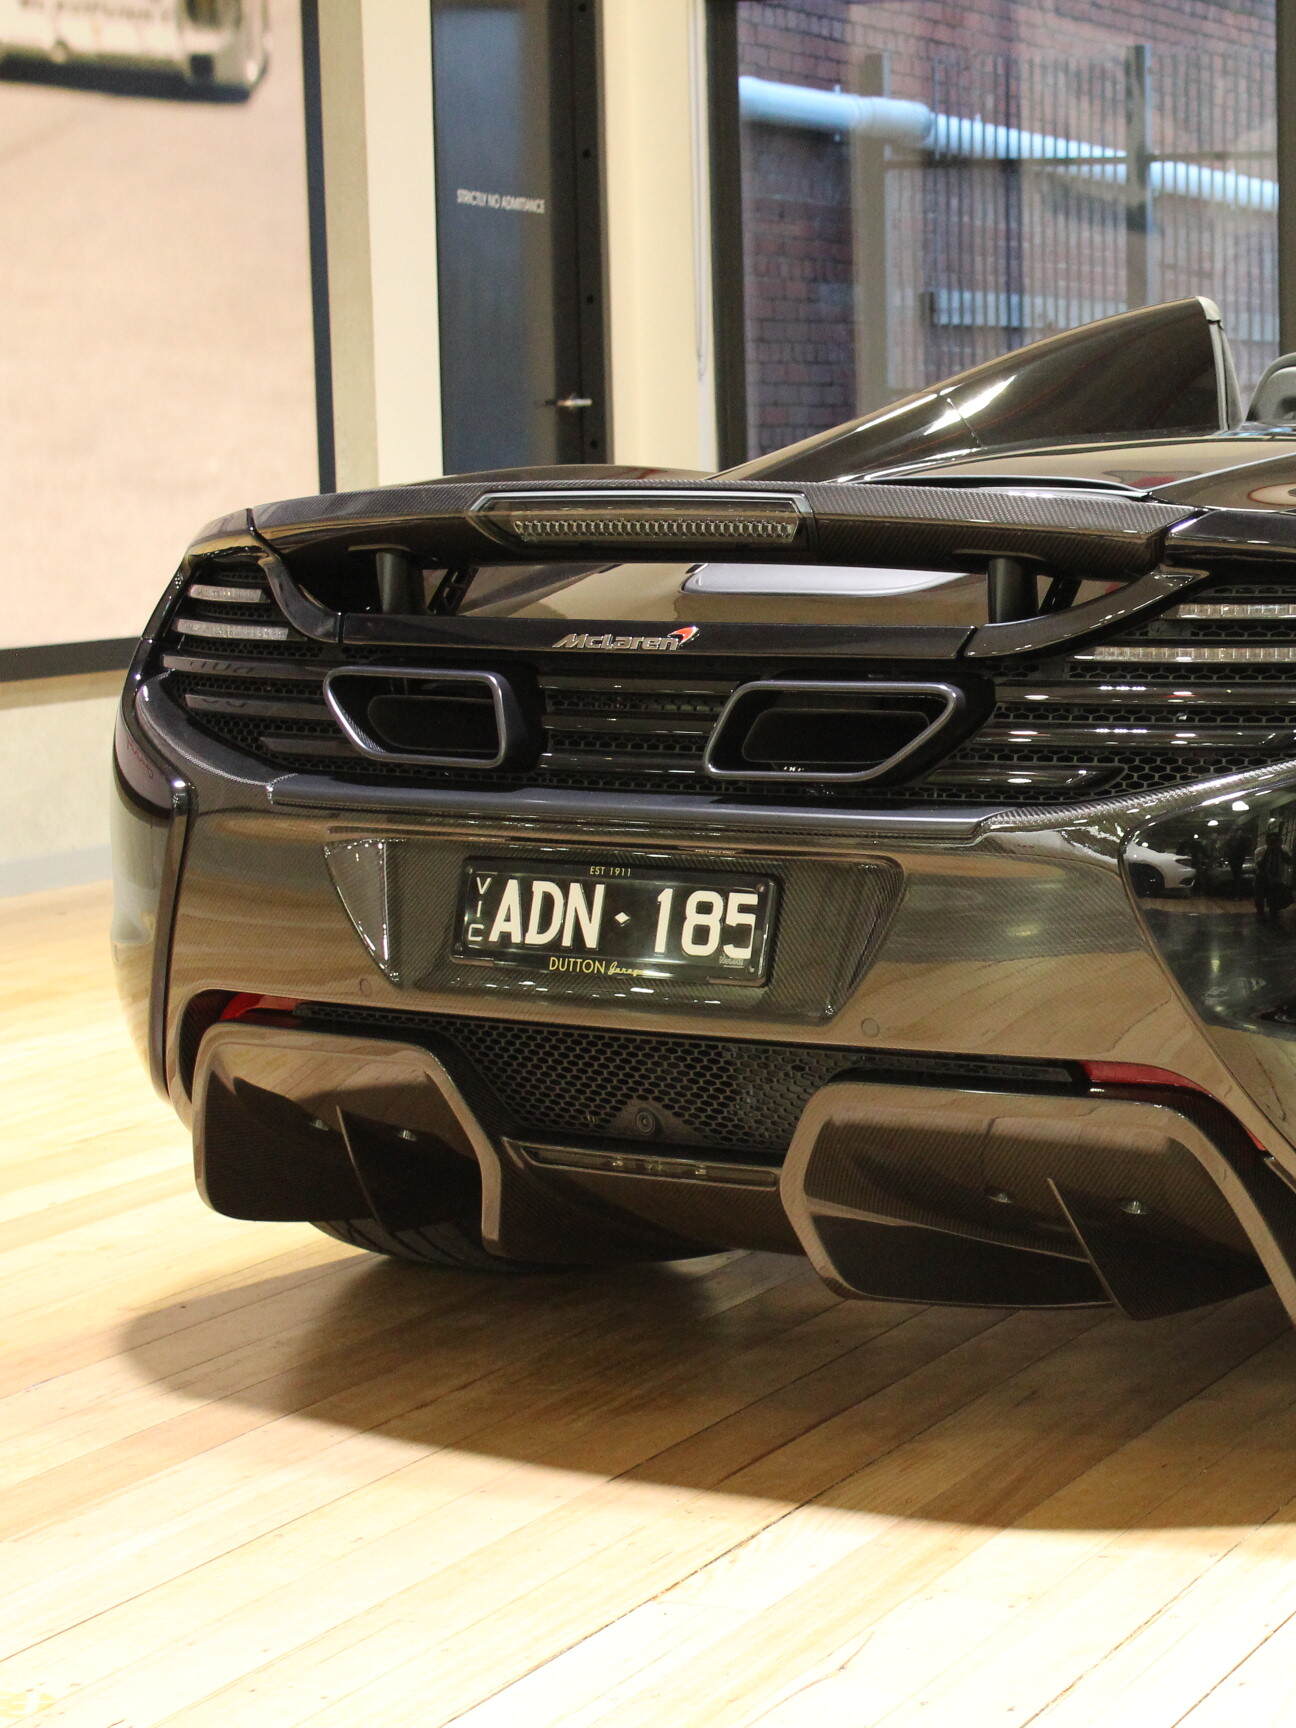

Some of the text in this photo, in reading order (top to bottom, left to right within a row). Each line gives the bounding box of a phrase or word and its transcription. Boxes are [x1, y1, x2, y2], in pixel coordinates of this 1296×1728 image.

[488, 193, 501, 210] NO
[552, 633, 679, 650] McLaren
[590, 865, 631, 878] EST 1911
[468, 876, 491, 942] VIC
[488, 879, 759, 960] ADN 185
[549, 956, 606, 974] DUTTON
